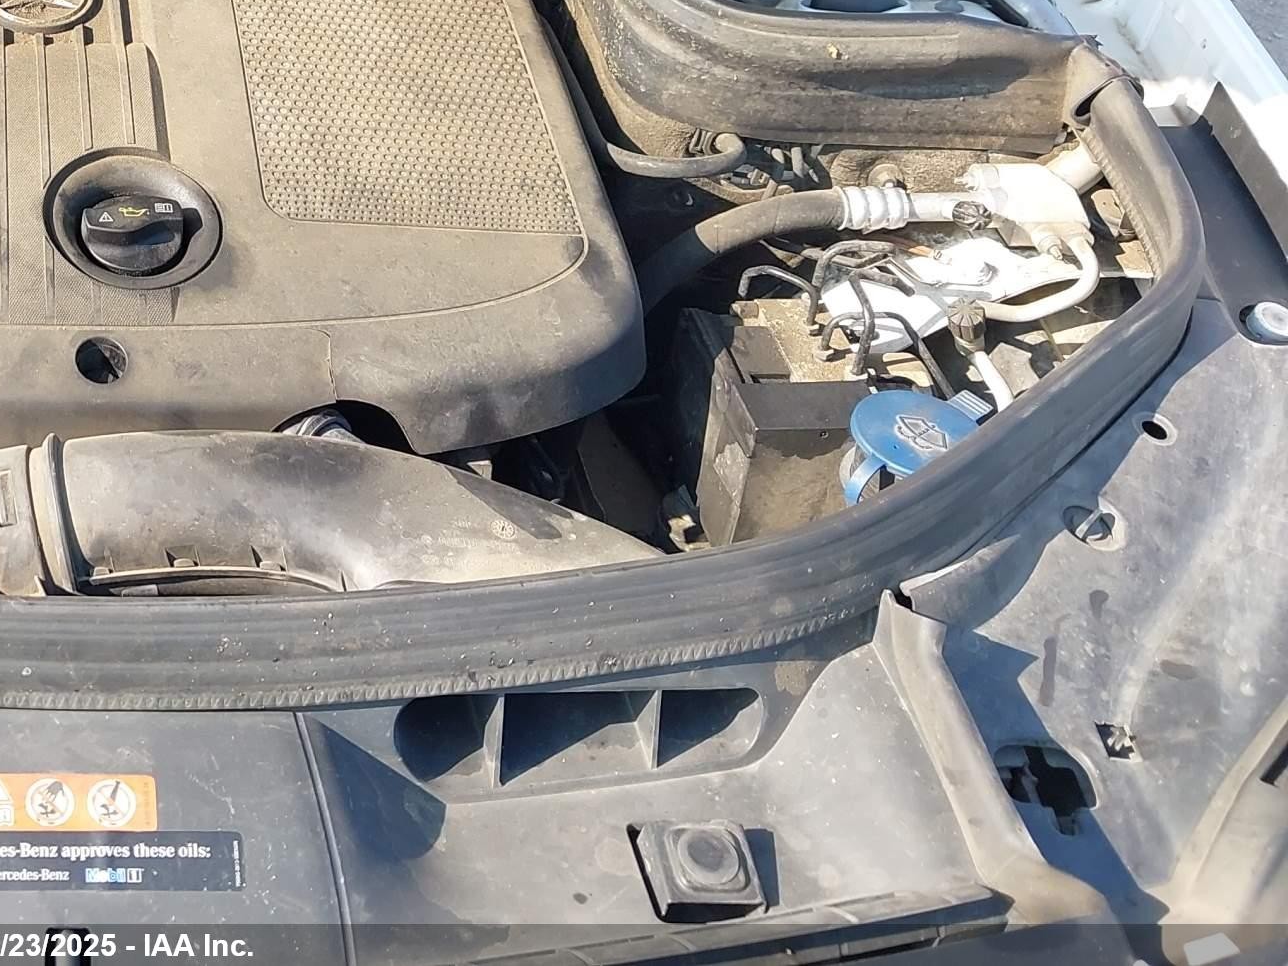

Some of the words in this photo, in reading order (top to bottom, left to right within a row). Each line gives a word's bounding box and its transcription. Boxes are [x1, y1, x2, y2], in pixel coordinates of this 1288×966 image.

[61, 845, 131, 861] approves
[133, 842, 175, 858] these
[177, 842, 212, 858] oils:
